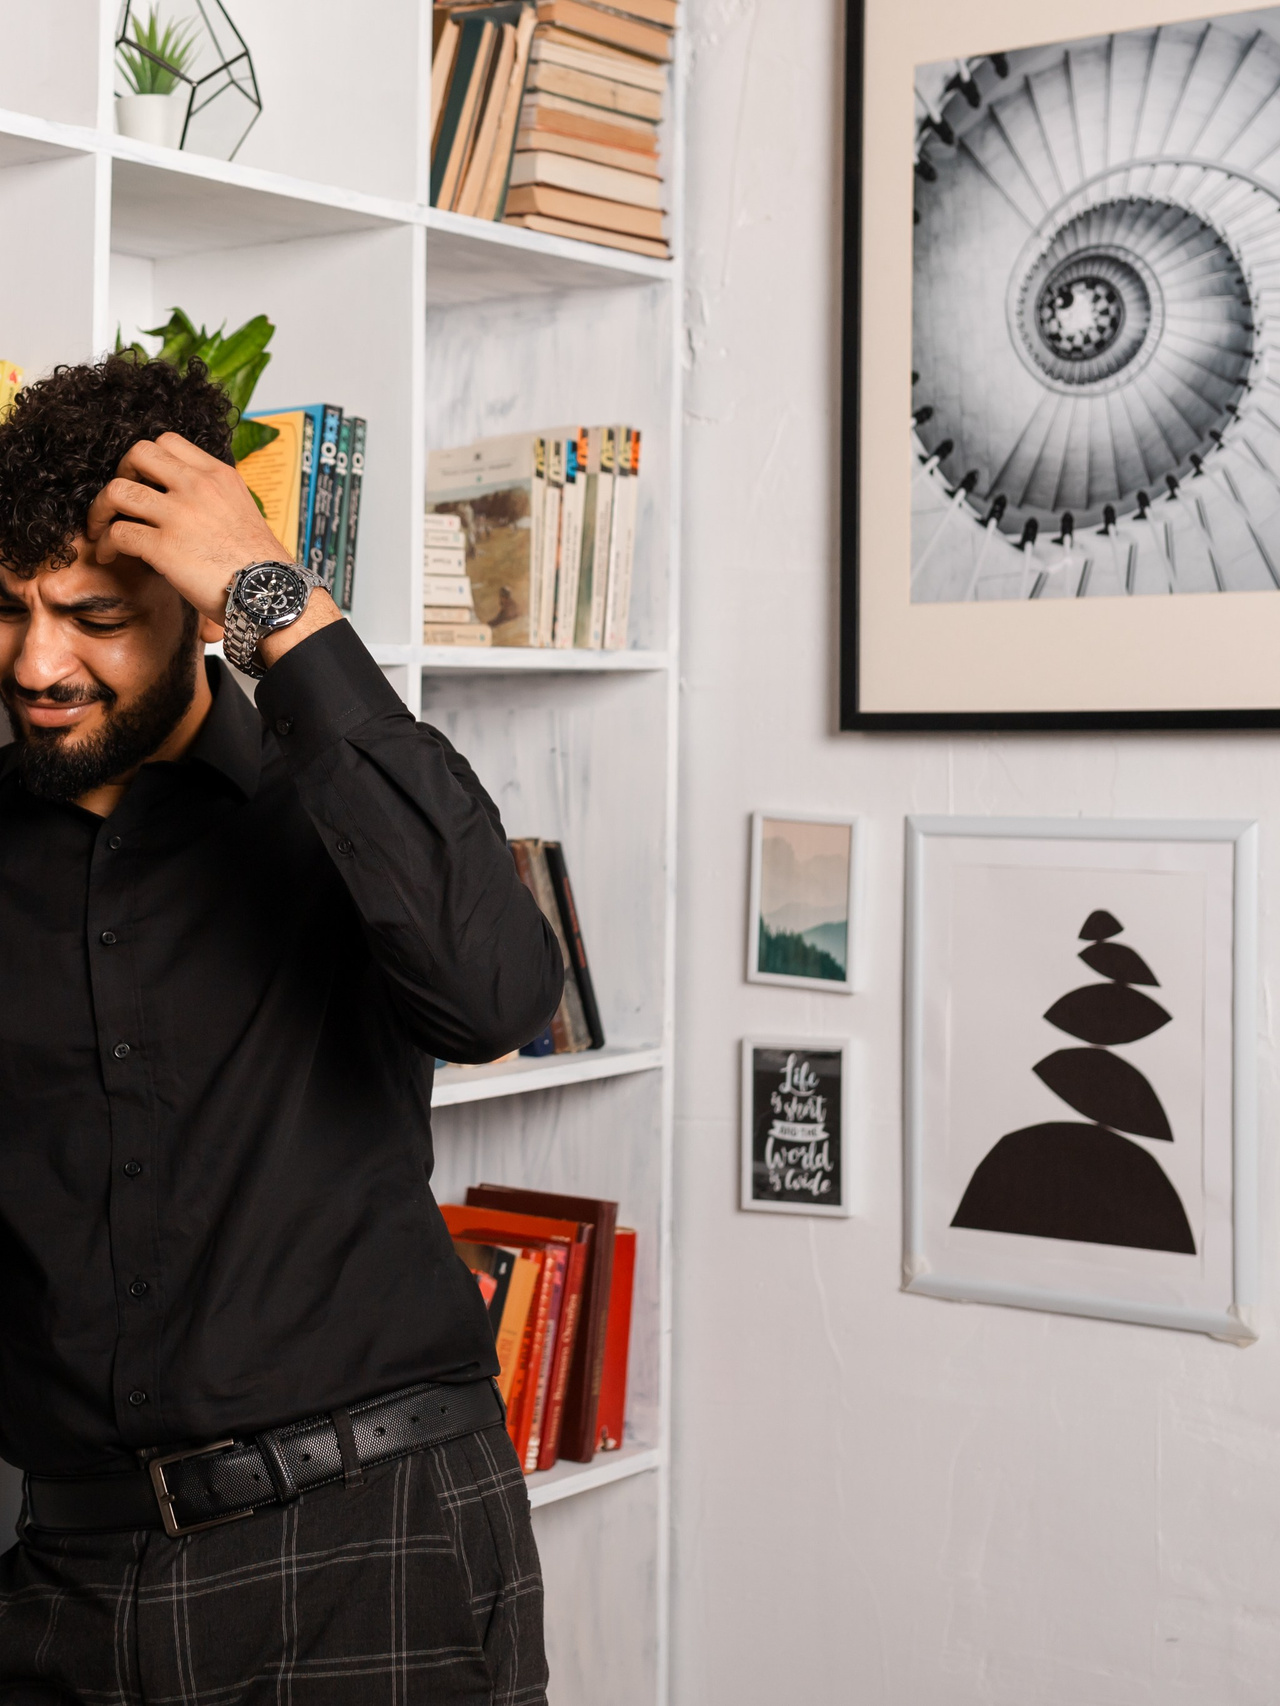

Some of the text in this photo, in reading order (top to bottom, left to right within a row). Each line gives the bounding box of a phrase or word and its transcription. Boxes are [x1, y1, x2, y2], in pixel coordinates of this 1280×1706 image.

[779, 1053, 821, 1097] Life
[770, 1091, 827, 1122] is short
[769, 1169, 782, 1192] is
